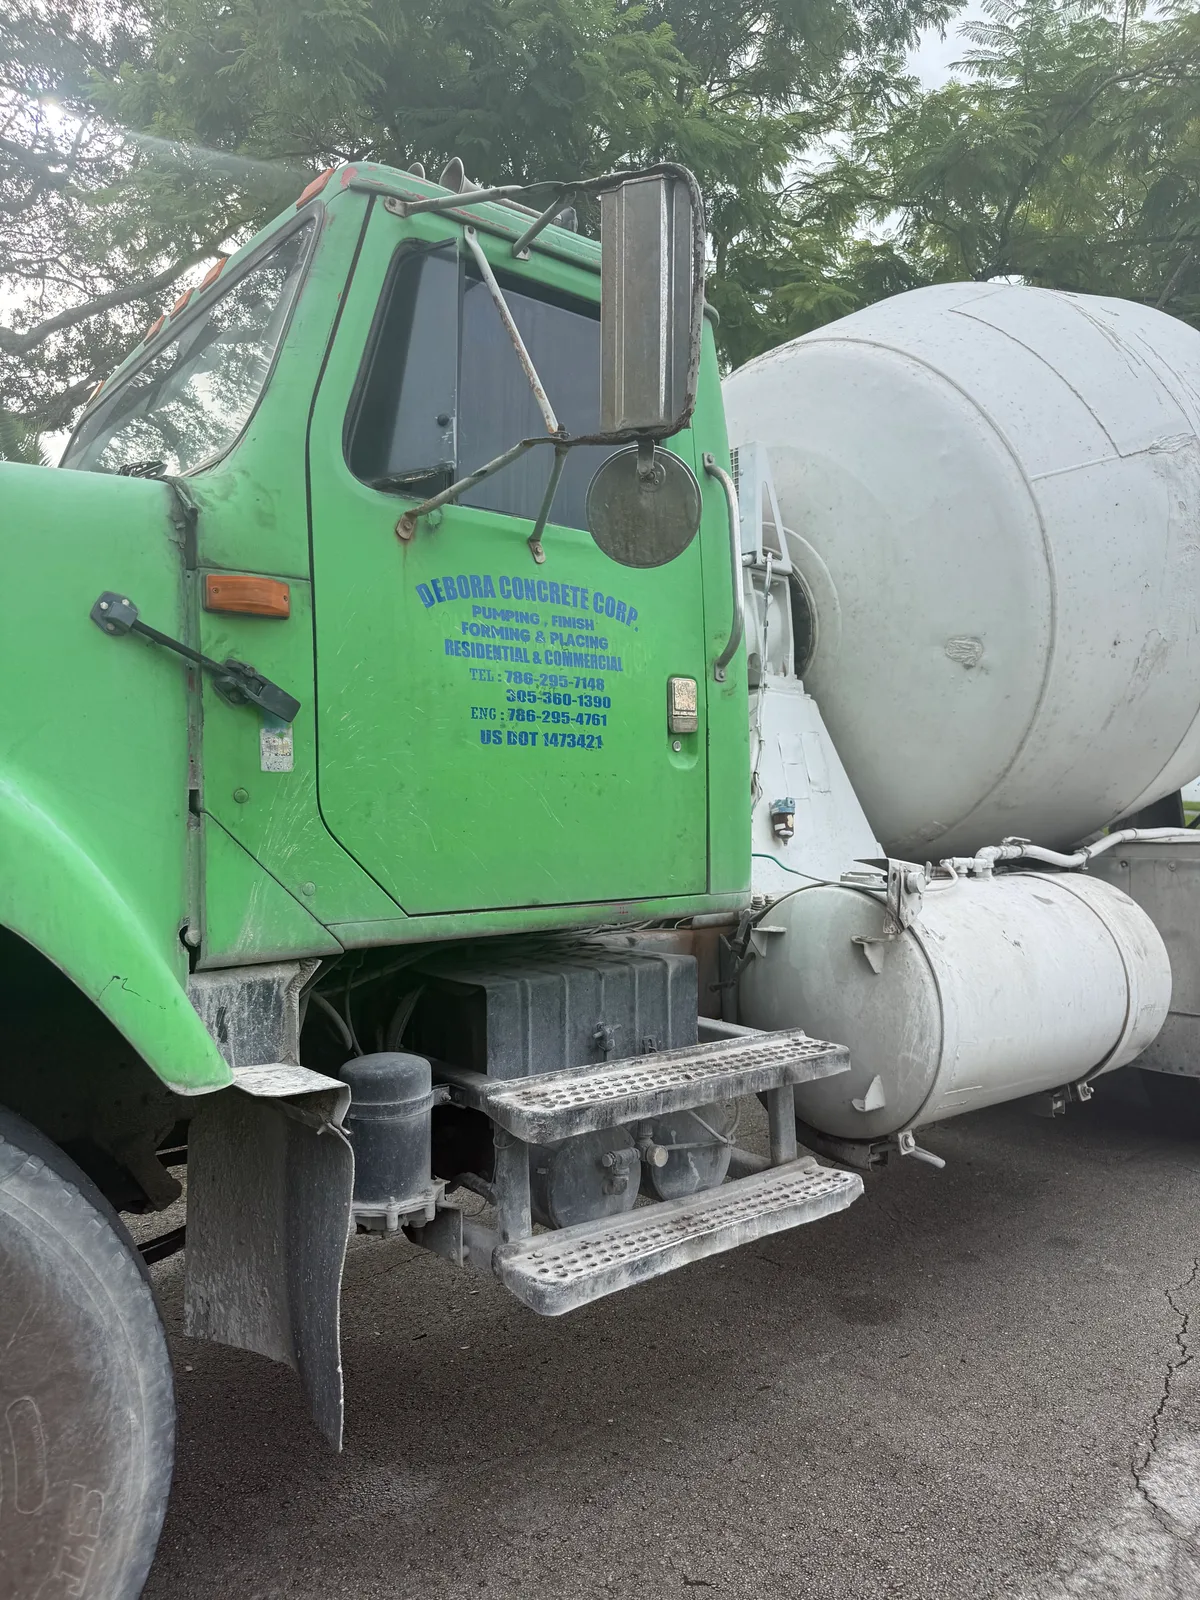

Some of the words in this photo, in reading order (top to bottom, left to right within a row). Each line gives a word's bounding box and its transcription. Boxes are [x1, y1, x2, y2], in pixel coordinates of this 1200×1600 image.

[416, 574, 496, 608] DEBORA
[499, 575, 589, 610] CONCRETE
[593, 592, 638, 632] CORP.
[472, 605, 539, 625] PUMPING
[552, 615, 594, 631] FINISH
[461, 621, 530, 642] FORMING
[535, 630, 545, 643] &
[550, 631, 608, 650] PLACING
[445, 639, 530, 663] RESIDENTIAL
[532, 651, 542, 664] &
[545, 649, 623, 672] COMMERCIAL
[505, 670, 605, 690] 786-295-7148
[506, 689, 611, 709] 305-360-1390
[508, 708, 607, 726] 786-295-4761
[480, 729, 502, 745] US
[507, 730, 538, 746] DOT
[543, 732, 602, 749] 1473421
